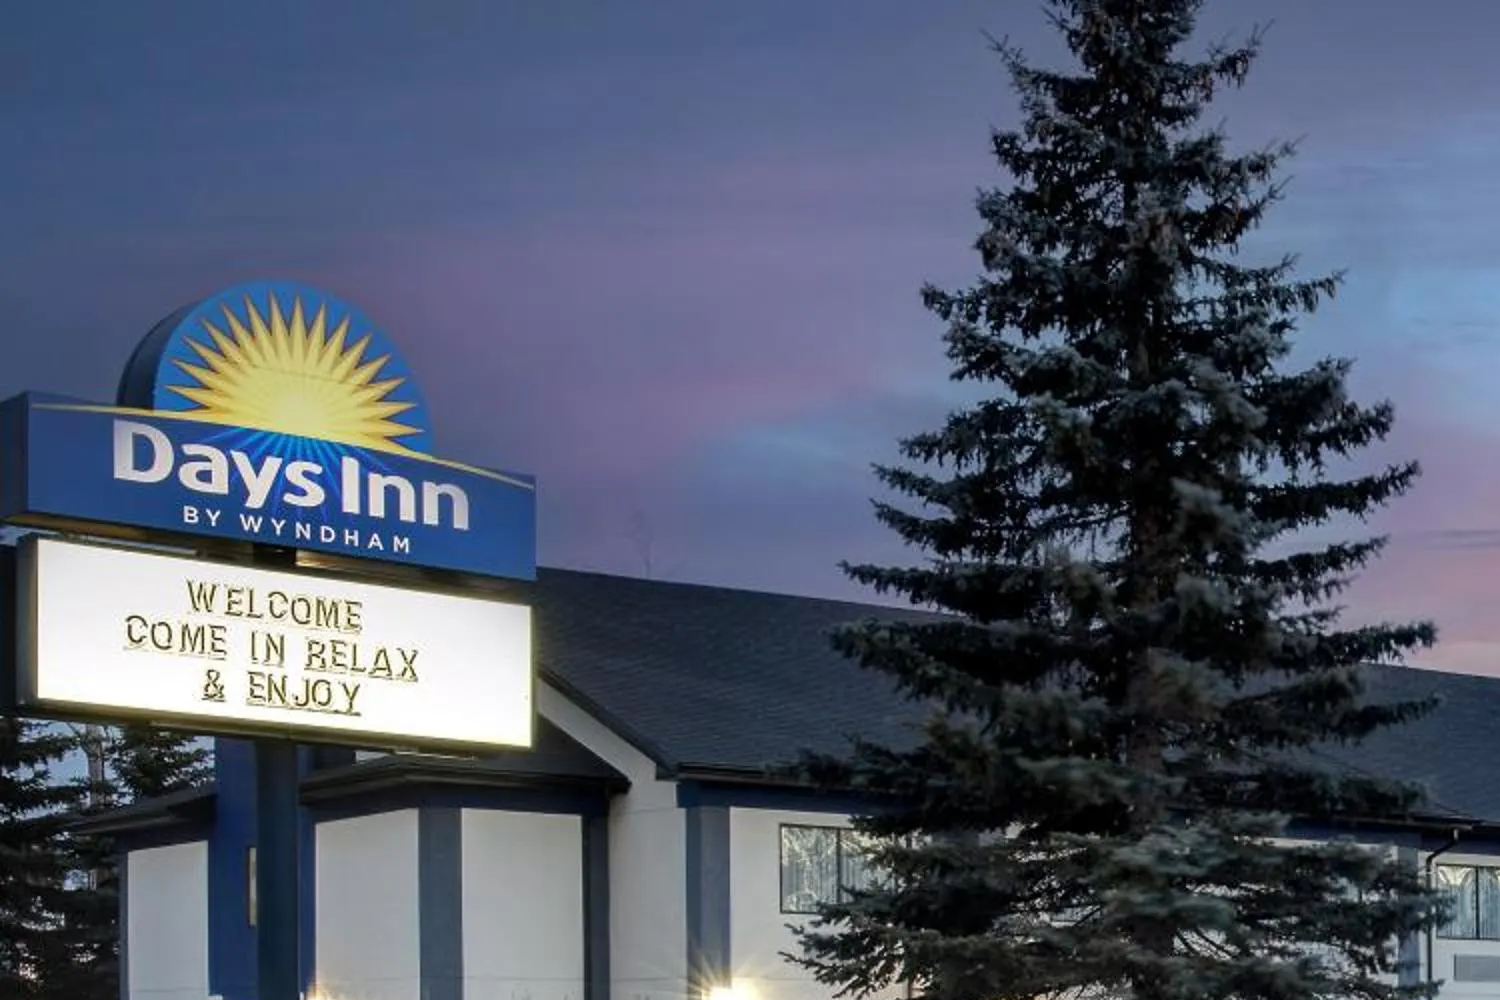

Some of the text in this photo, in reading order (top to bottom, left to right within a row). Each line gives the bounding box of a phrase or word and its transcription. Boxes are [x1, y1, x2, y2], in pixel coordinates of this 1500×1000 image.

[113, 418, 470, 531] Days Inn
[183, 505, 410, 553] BY WYNDHAM
[187, 580, 363, 632] WELCOME
[124, 615, 418, 682] COME IN RELAX
[202, 669, 361, 716] & ENJOY
